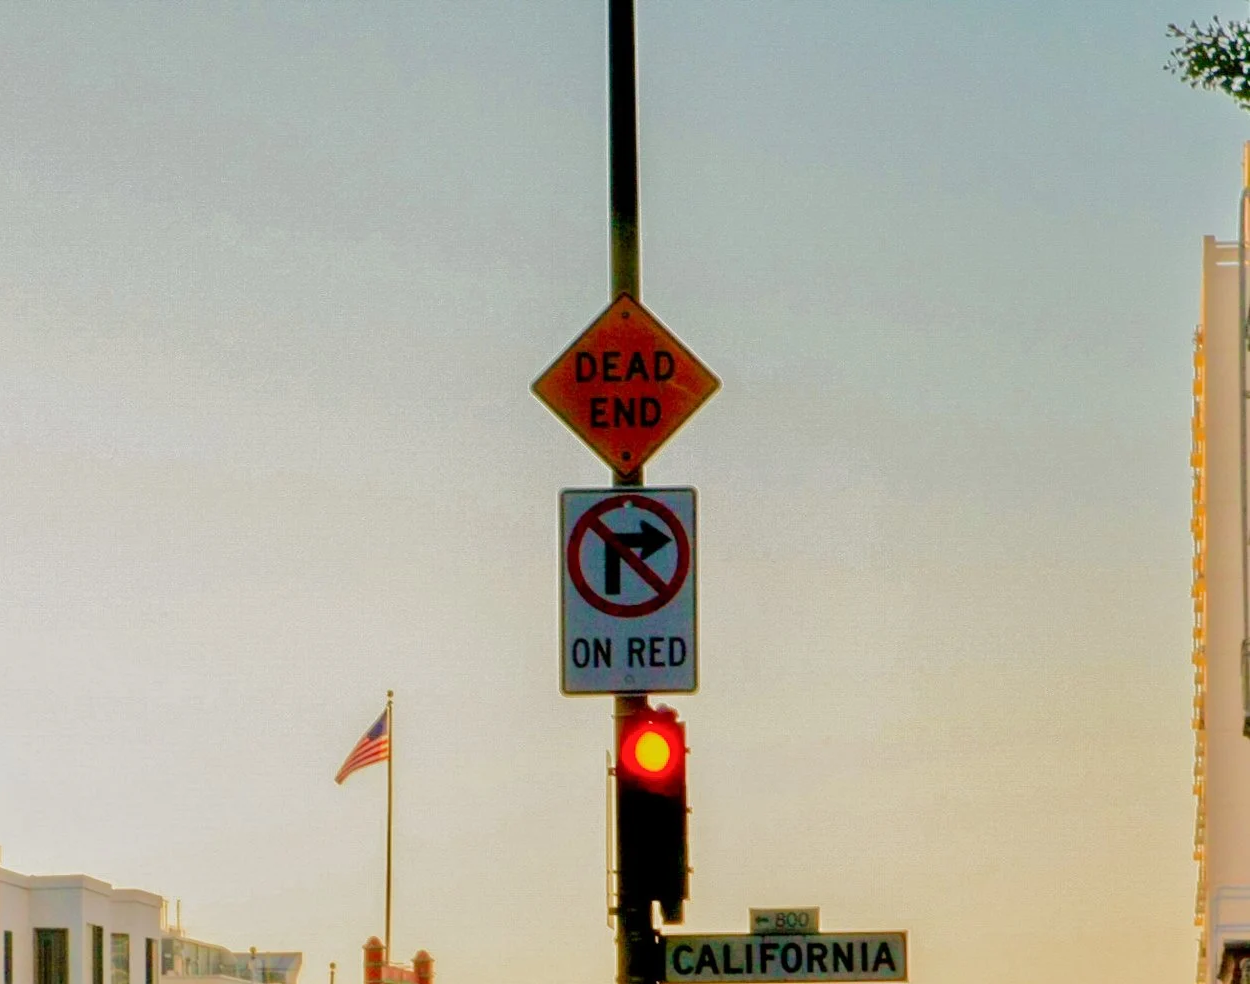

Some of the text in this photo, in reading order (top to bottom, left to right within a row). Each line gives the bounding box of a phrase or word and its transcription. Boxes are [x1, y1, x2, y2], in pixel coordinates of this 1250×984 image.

[575, 351, 675, 383] DEAD
[589, 397, 663, 428] END
[571, 636, 687, 669] ON RED
[775, 911, 810, 928] 800
[672, 941, 896, 975] CALIFORNIA
